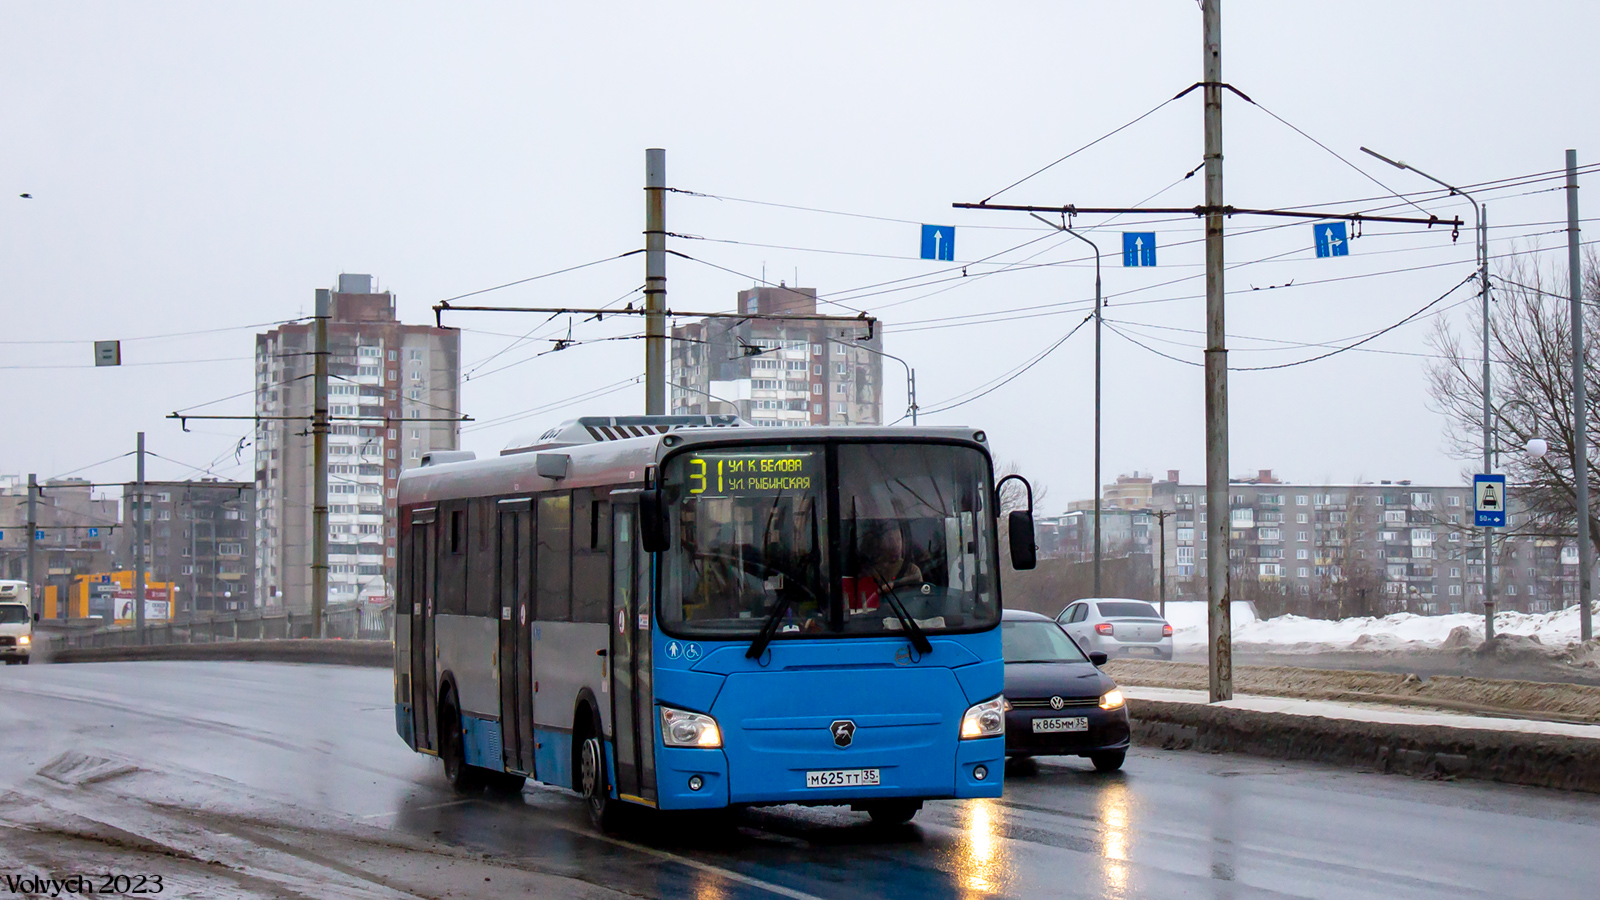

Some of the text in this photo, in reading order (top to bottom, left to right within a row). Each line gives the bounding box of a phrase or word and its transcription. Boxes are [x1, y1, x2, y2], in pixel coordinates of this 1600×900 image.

[728, 459, 802, 472] УЛ. К. БЕЛОВА
[690, 459, 723, 493] 31
[728, 477, 810, 490] УЛ. РЫБИНСКАЯ
